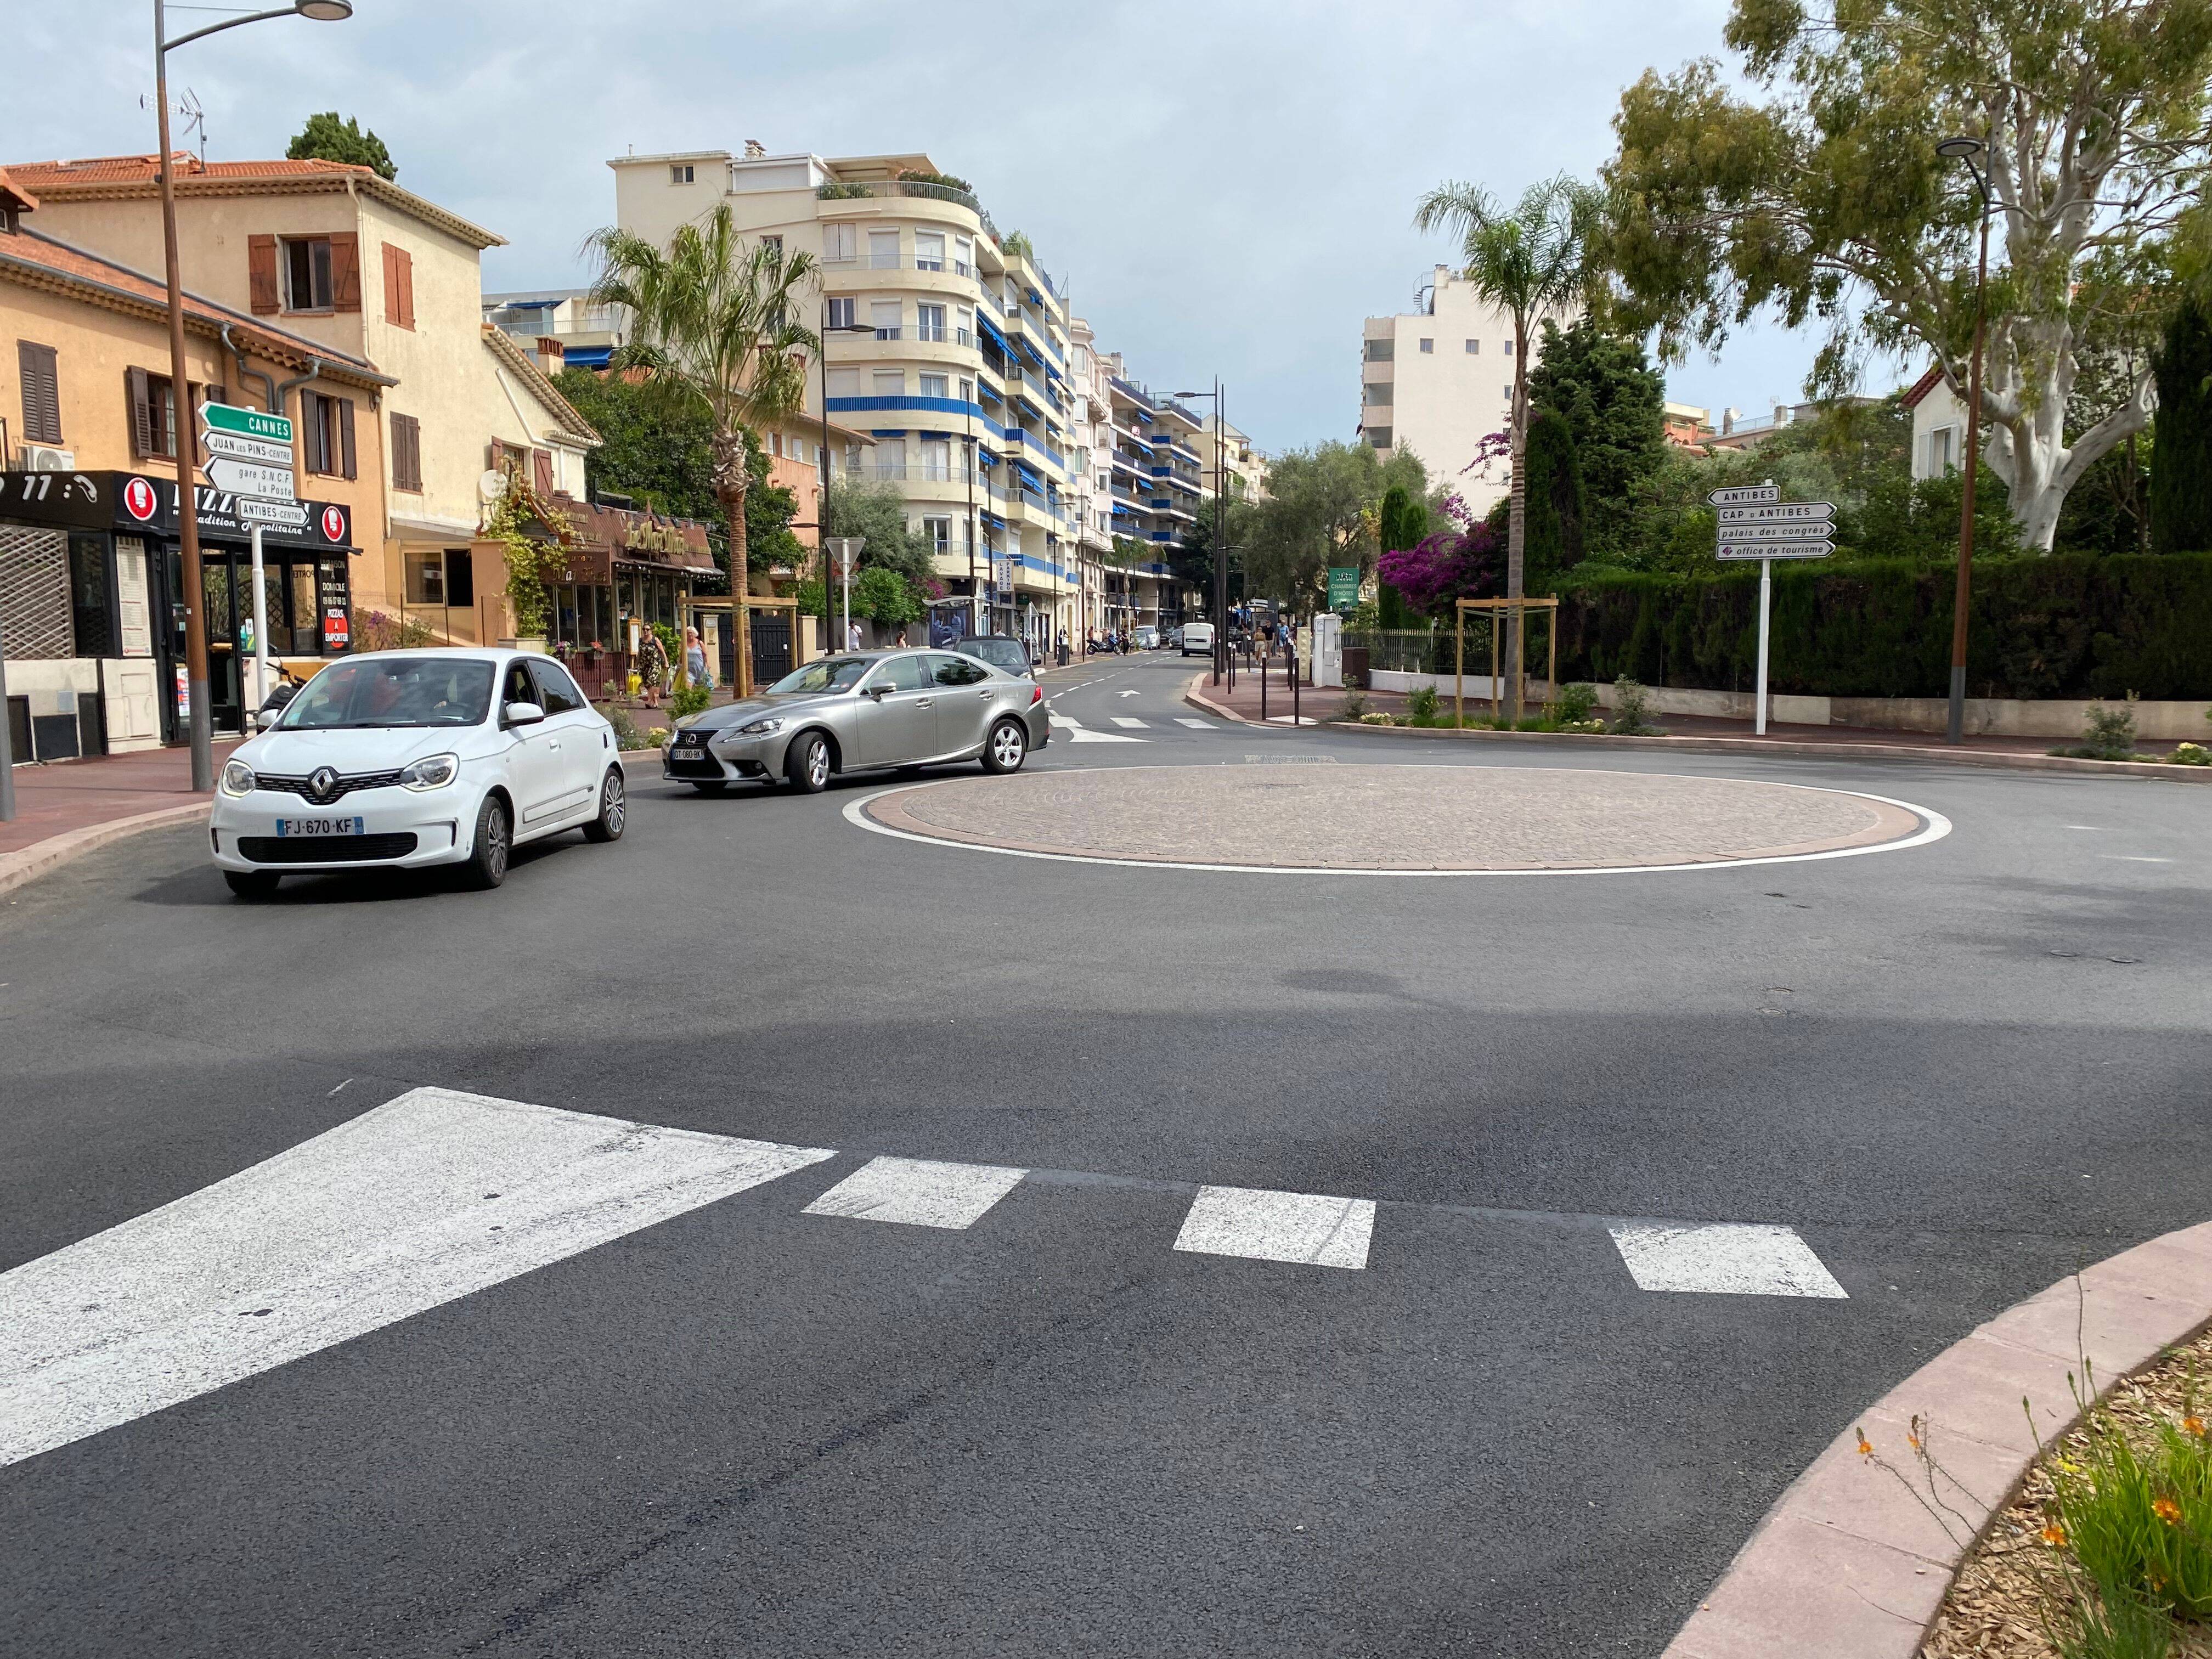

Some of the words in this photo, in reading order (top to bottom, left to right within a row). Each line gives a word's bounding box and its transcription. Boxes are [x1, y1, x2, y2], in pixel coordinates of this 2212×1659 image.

[249, 416, 289, 436] CANNES
[213, 437, 234, 451] JUAN
[239, 469, 257, 479] gare
[261, 470, 291, 484] S.N.C.F.
[258, 482, 266, 492] La
[270, 484, 292, 497] Poste
[1724, 490, 1775, 501] ANTIBES
[1723, 510, 1744, 519] CAP
[1722, 529, 1753, 539] palais
[1759, 528, 1776, 536] des
[1783, 526, 1824, 537] congrès
[1737, 546, 1763, 555] office
[1767, 546, 1778, 554] de
[1782, 545, 1824, 554] tourisme
[328, 609, 344, 618] PIZZAS
[325, 633, 348, 642] EMPORTER
